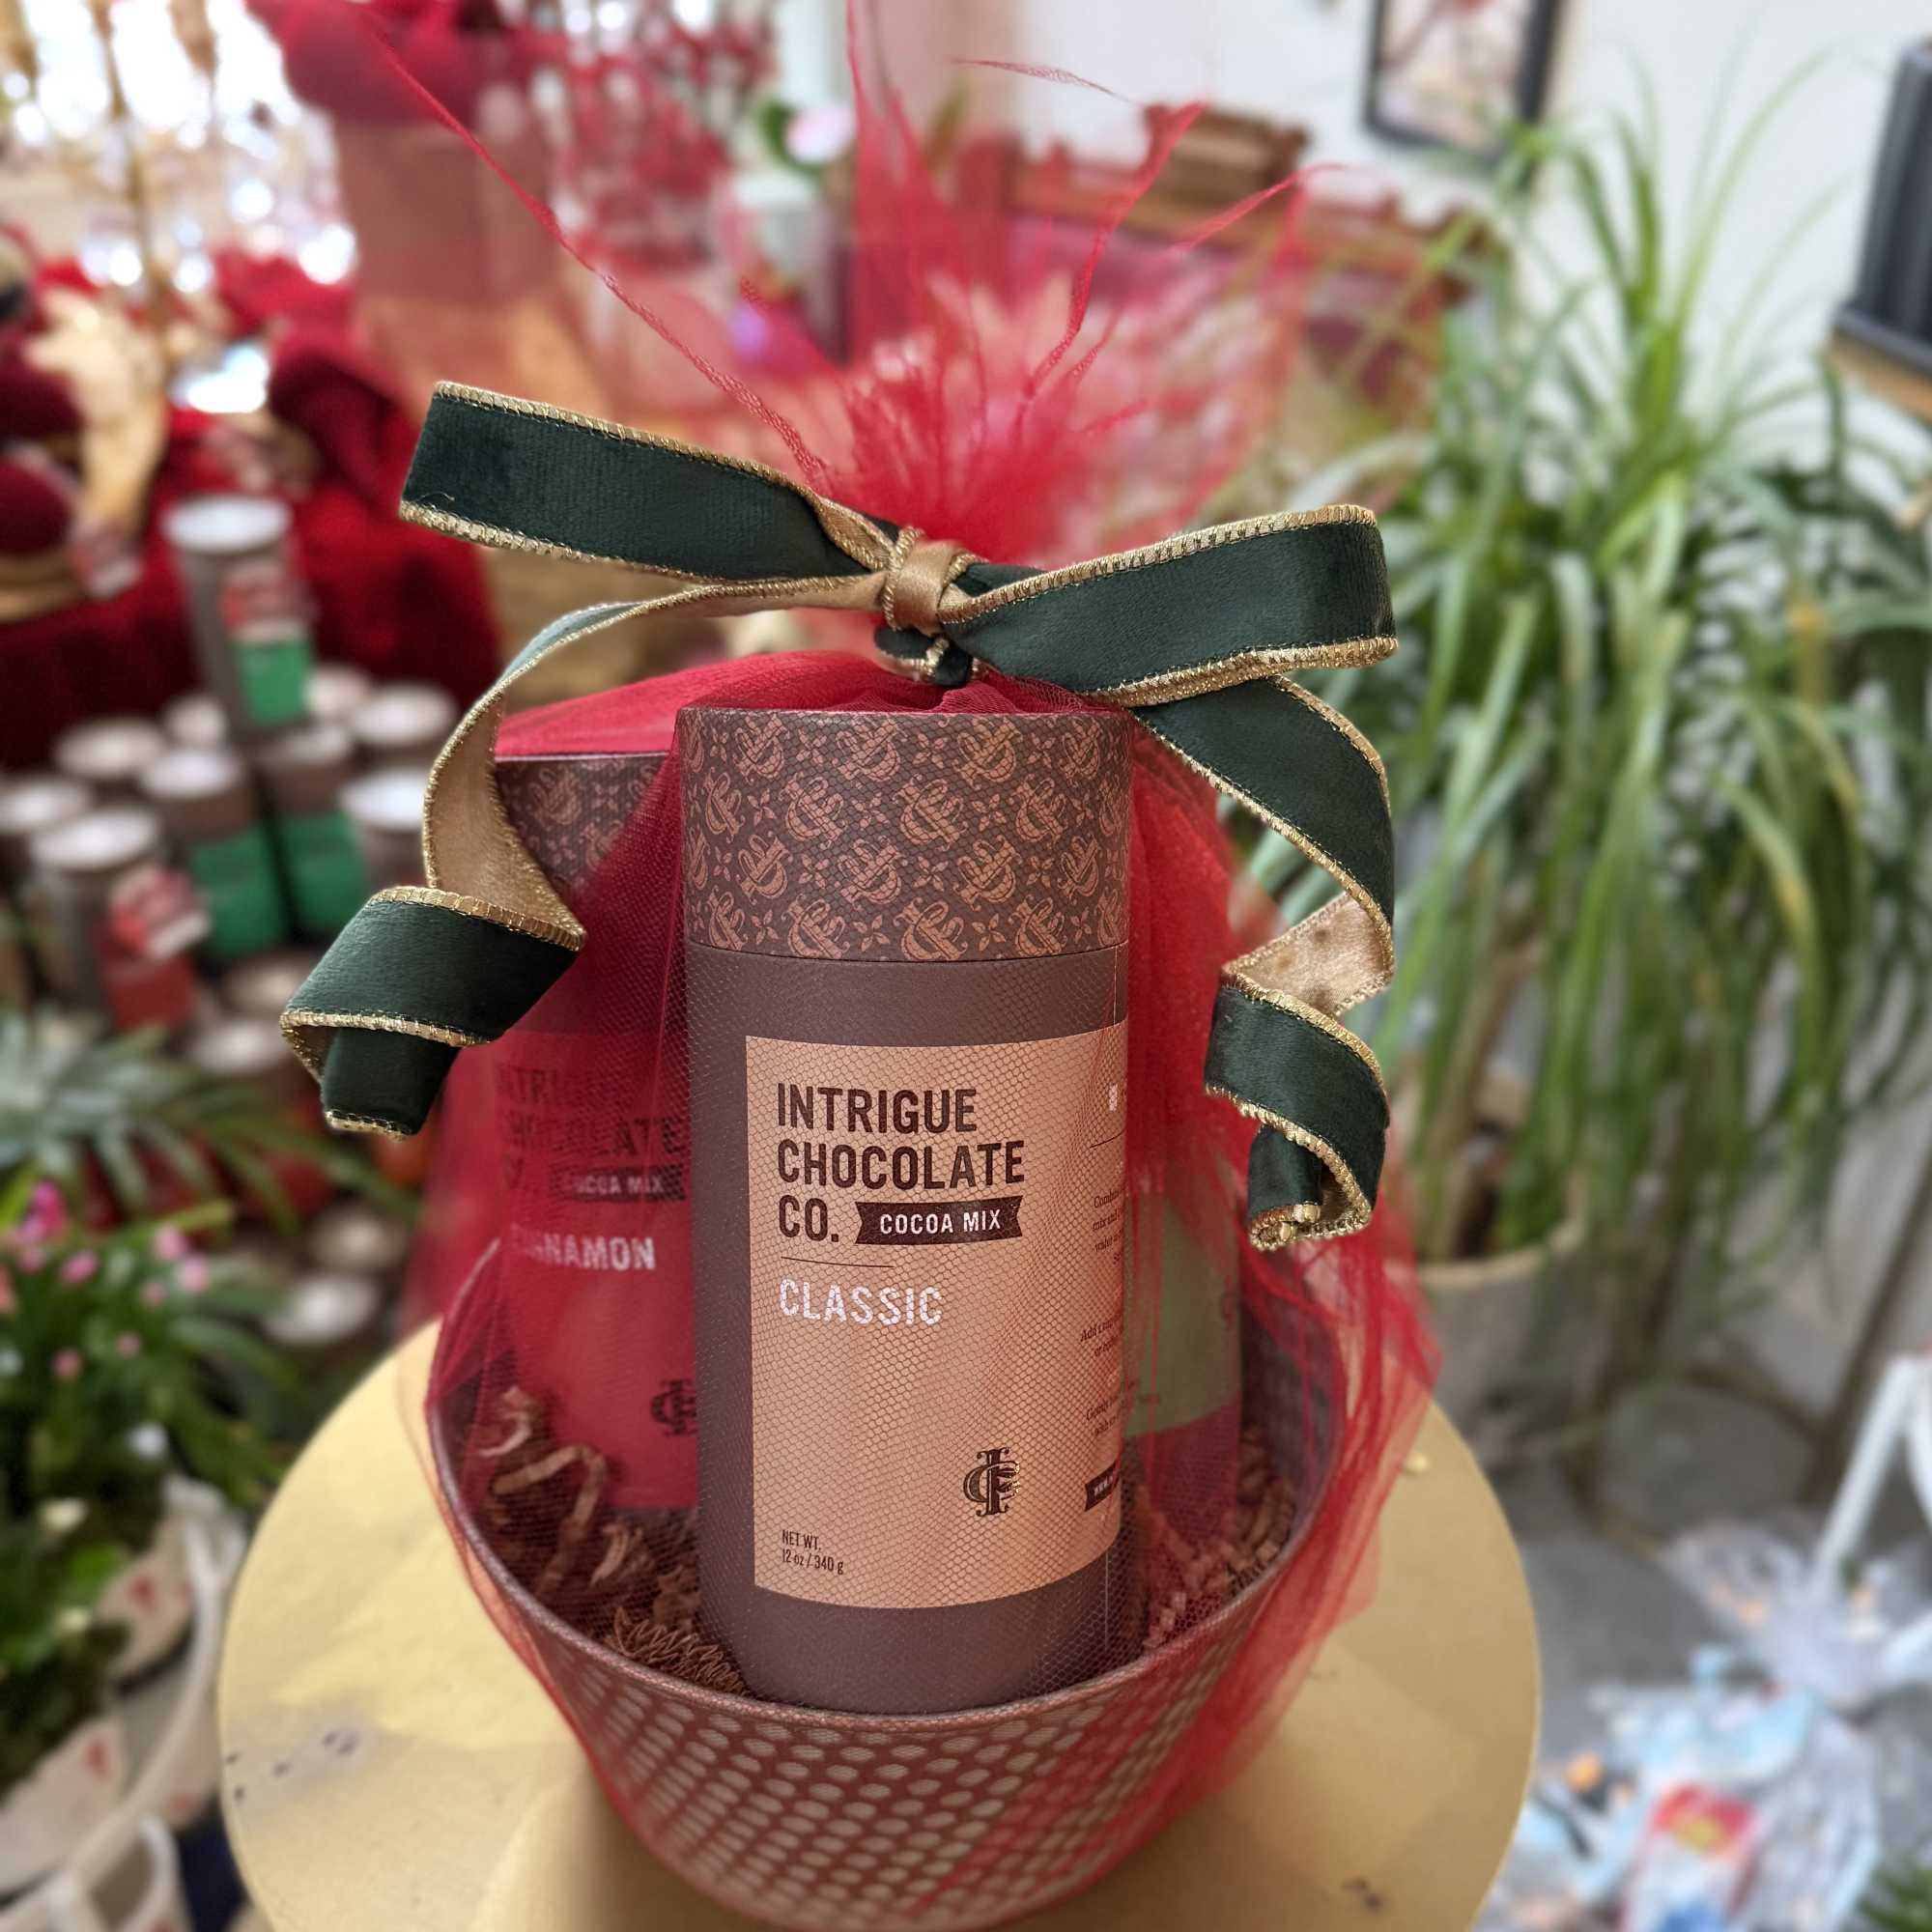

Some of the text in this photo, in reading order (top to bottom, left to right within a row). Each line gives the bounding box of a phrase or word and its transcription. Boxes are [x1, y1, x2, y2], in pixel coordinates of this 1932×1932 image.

[777, 1082, 978, 1134] INTRIGUE
[777, 1138, 1026, 1190] CHOCOLATE
[779, 1194, 839, 1243] CO.
[879, 1208, 1003, 1236] COCOA MIX
[779, 1278, 943, 1326] CLASSIC
[781, 1529, 801, 1546] NET
[781, 1548, 792, 1563] 12
[793, 1554, 804, 1566] oz
[813, 1554, 835, 1572] 340
[837, 1560, 844, 1576] g
